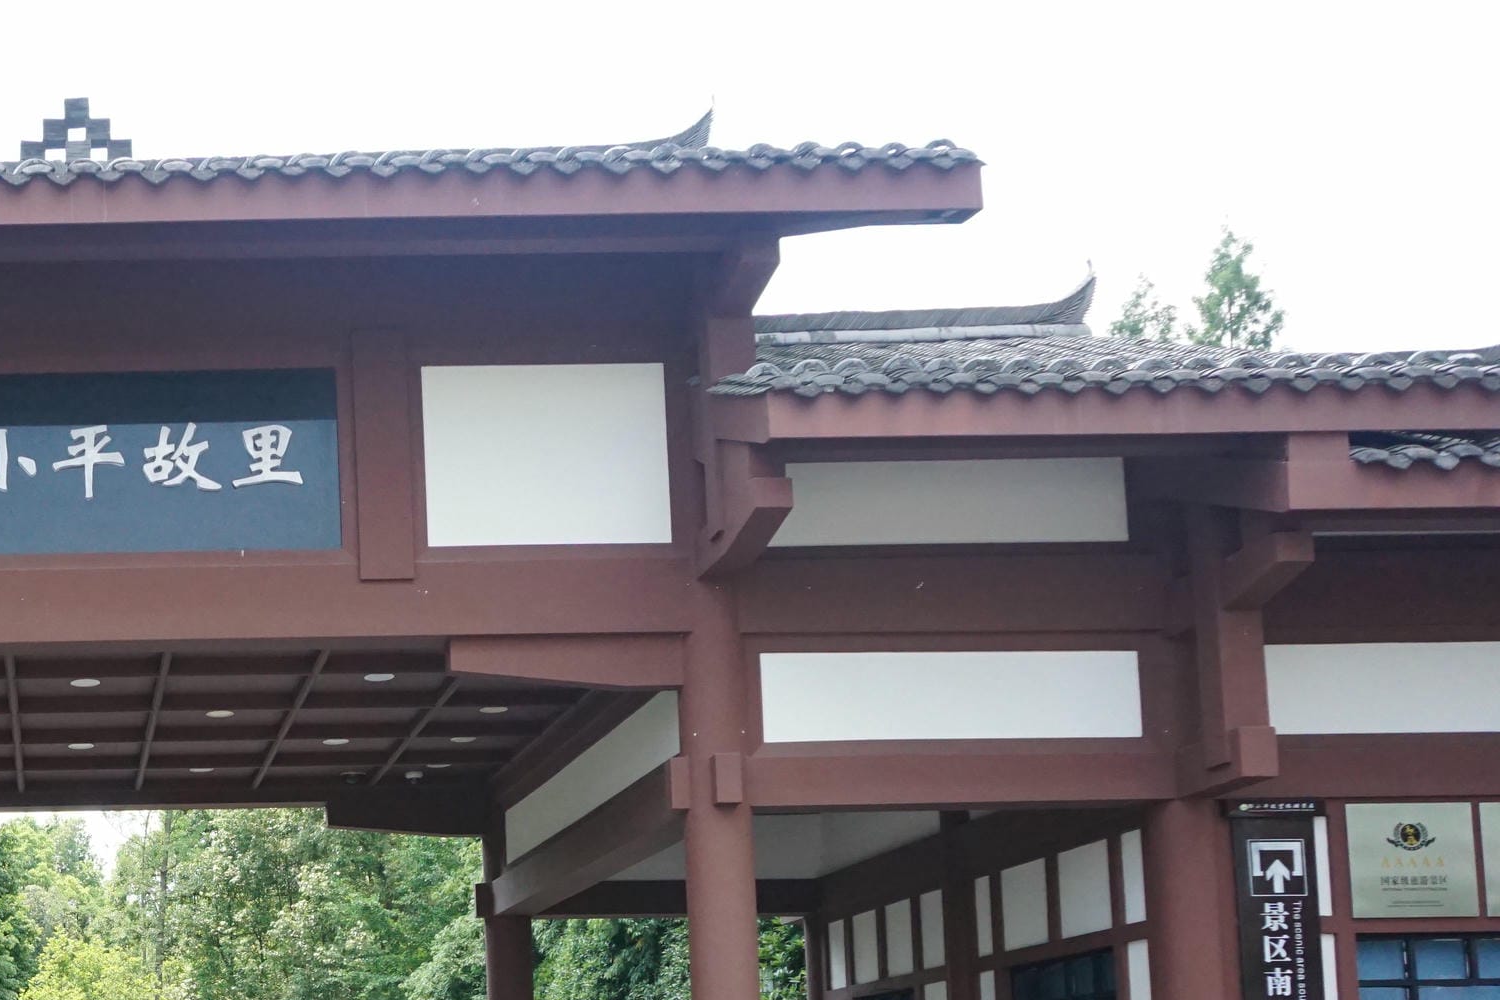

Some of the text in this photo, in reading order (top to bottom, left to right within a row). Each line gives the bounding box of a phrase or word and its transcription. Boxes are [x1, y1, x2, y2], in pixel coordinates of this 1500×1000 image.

[1292, 900, 1303, 920] The
[1293, 921, 1305, 955] scenic
[1295, 957, 1306, 980] area
